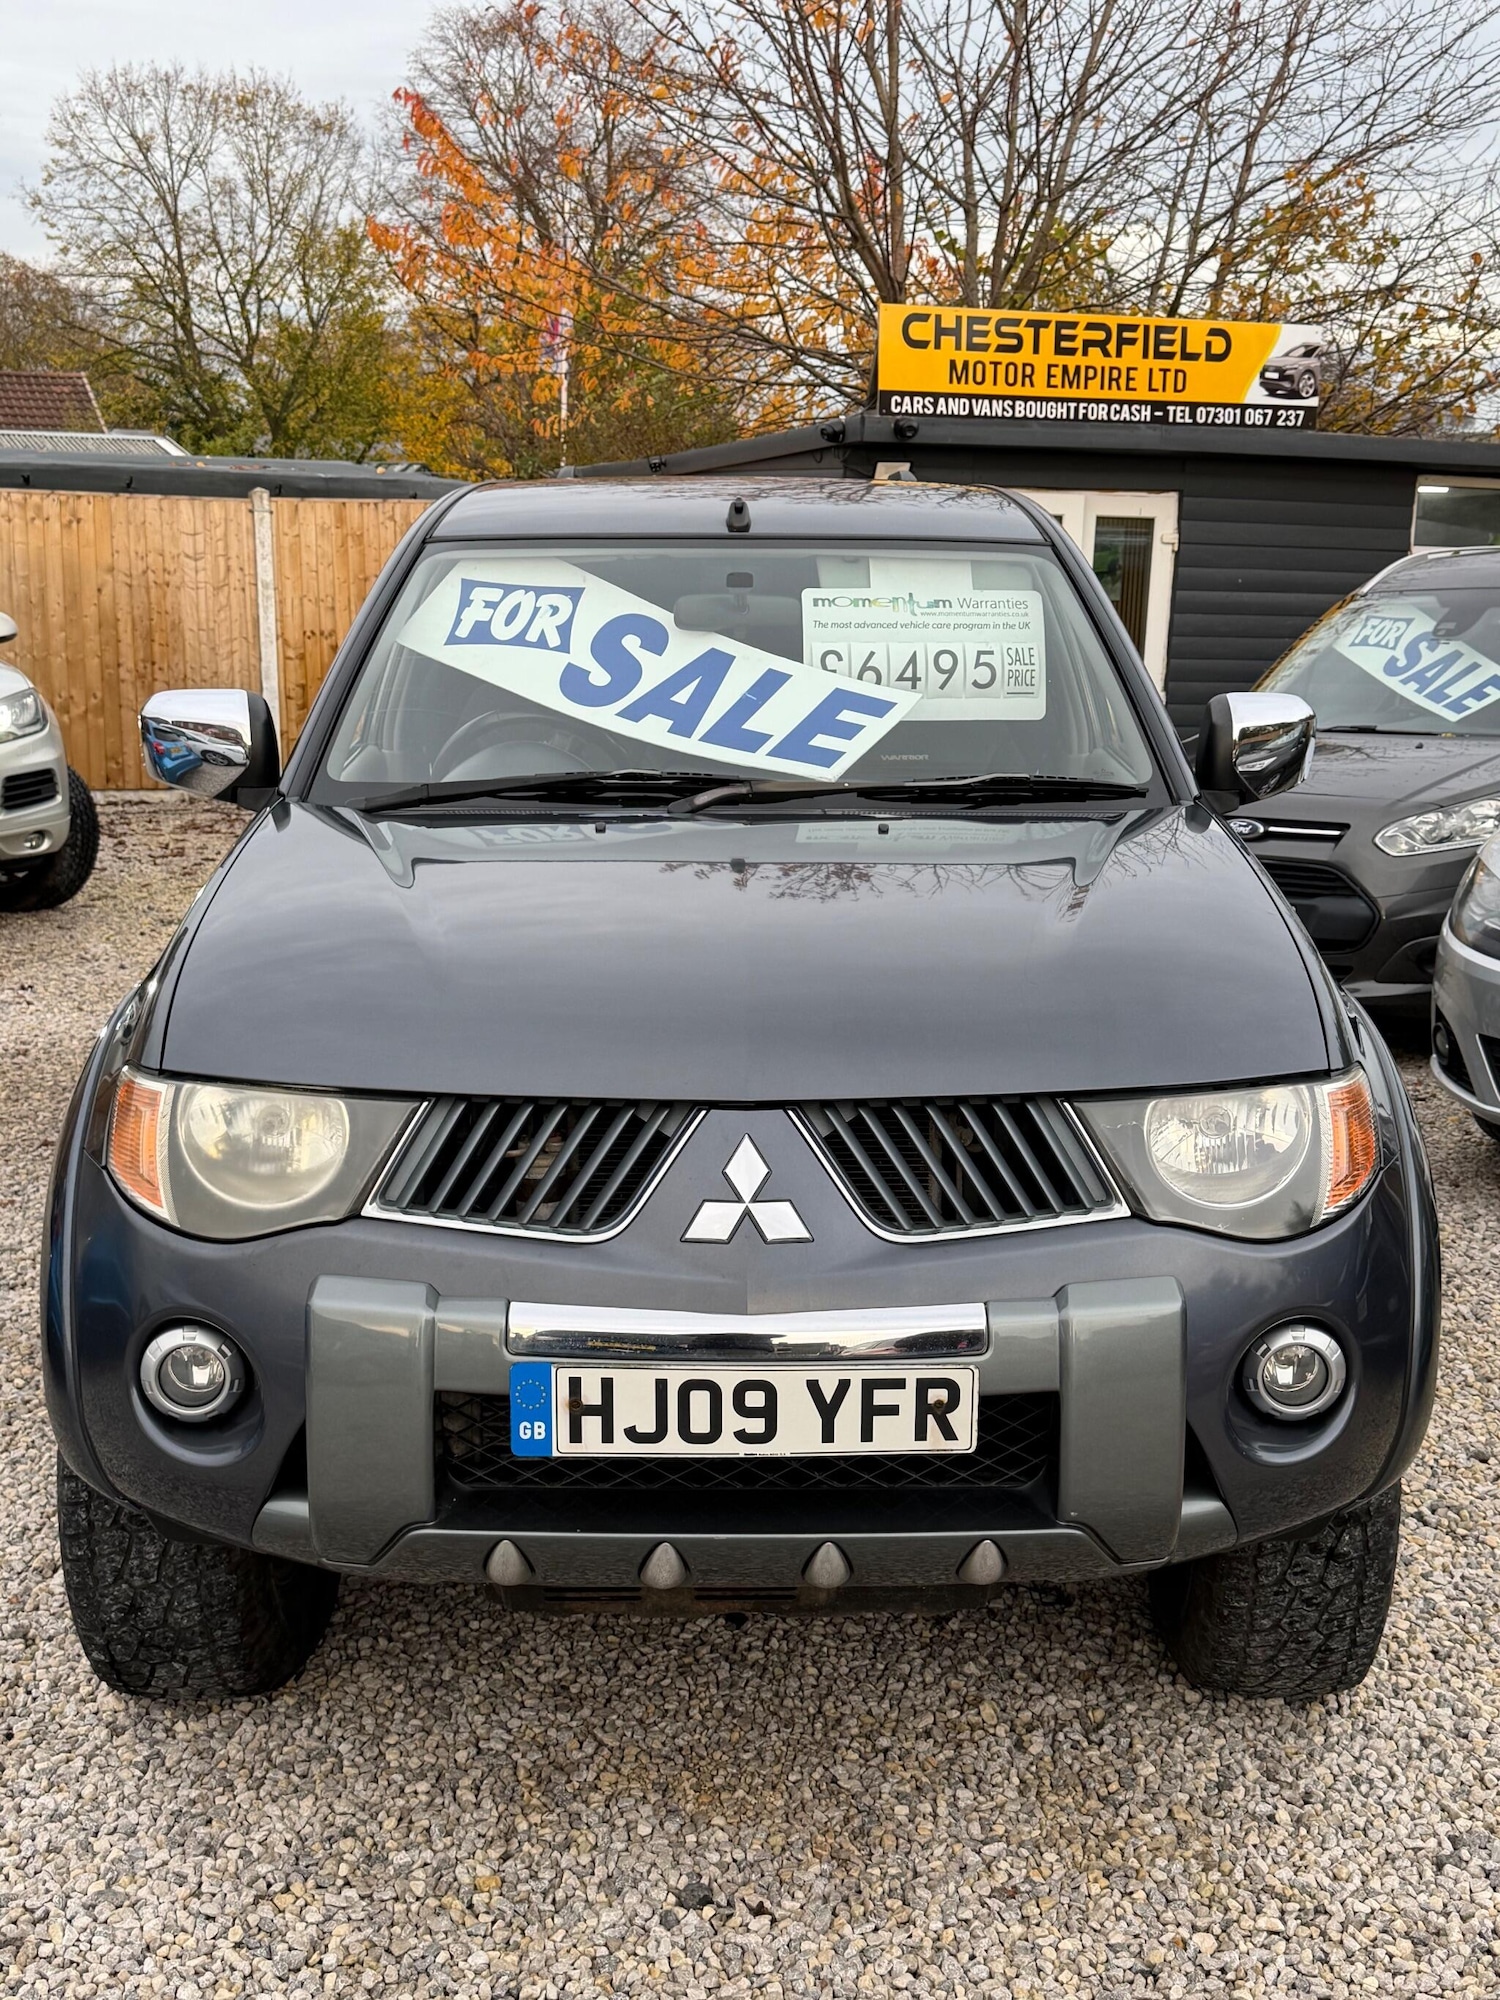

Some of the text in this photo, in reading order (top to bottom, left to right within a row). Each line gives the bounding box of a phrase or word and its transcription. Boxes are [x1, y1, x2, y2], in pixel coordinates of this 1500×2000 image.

[902, 312, 1232, 363] CHESTERFIELD
[949, 359, 1187, 393] MOTOR EMPIRE LTD
[890, 395, 934, 415] CARS
[936, 397, 970, 416] AND
[972, 398, 1014, 417] VANS
[1015, 400, 1077, 419] BOUGHT
[1078, 402, 1109, 421] FOR
[1110, 403, 1151, 422] CASH
[1167, 405, 1193, 424] TEL
[1196, 407, 1240, 425] 07301
[1245, 408, 1273, 426] 067
[1276, 410, 1305, 427] 237
[813, 592, 1029, 616] momentum Warranties
[813, 620, 829, 629] The
[830, 621, 852, 629] most
[854, 620, 898, 629] advanced
[900, 621, 930, 629] vehicle
[953, 622, 991, 631] program
[992, 621, 1001, 629] in
[1002, 621, 1016, 629] the
[1018, 621, 1031, 629] UK
[1006, 647, 1036, 666] SALE
[1354, 618, 1500, 715] FOR SALE
[454, 586, 898, 769] FOR SALE
[1007, 669, 1036, 687] PRICE
[568, 1376, 961, 1445] HJ09 YFR
[518, 1421, 546, 1440] GB
